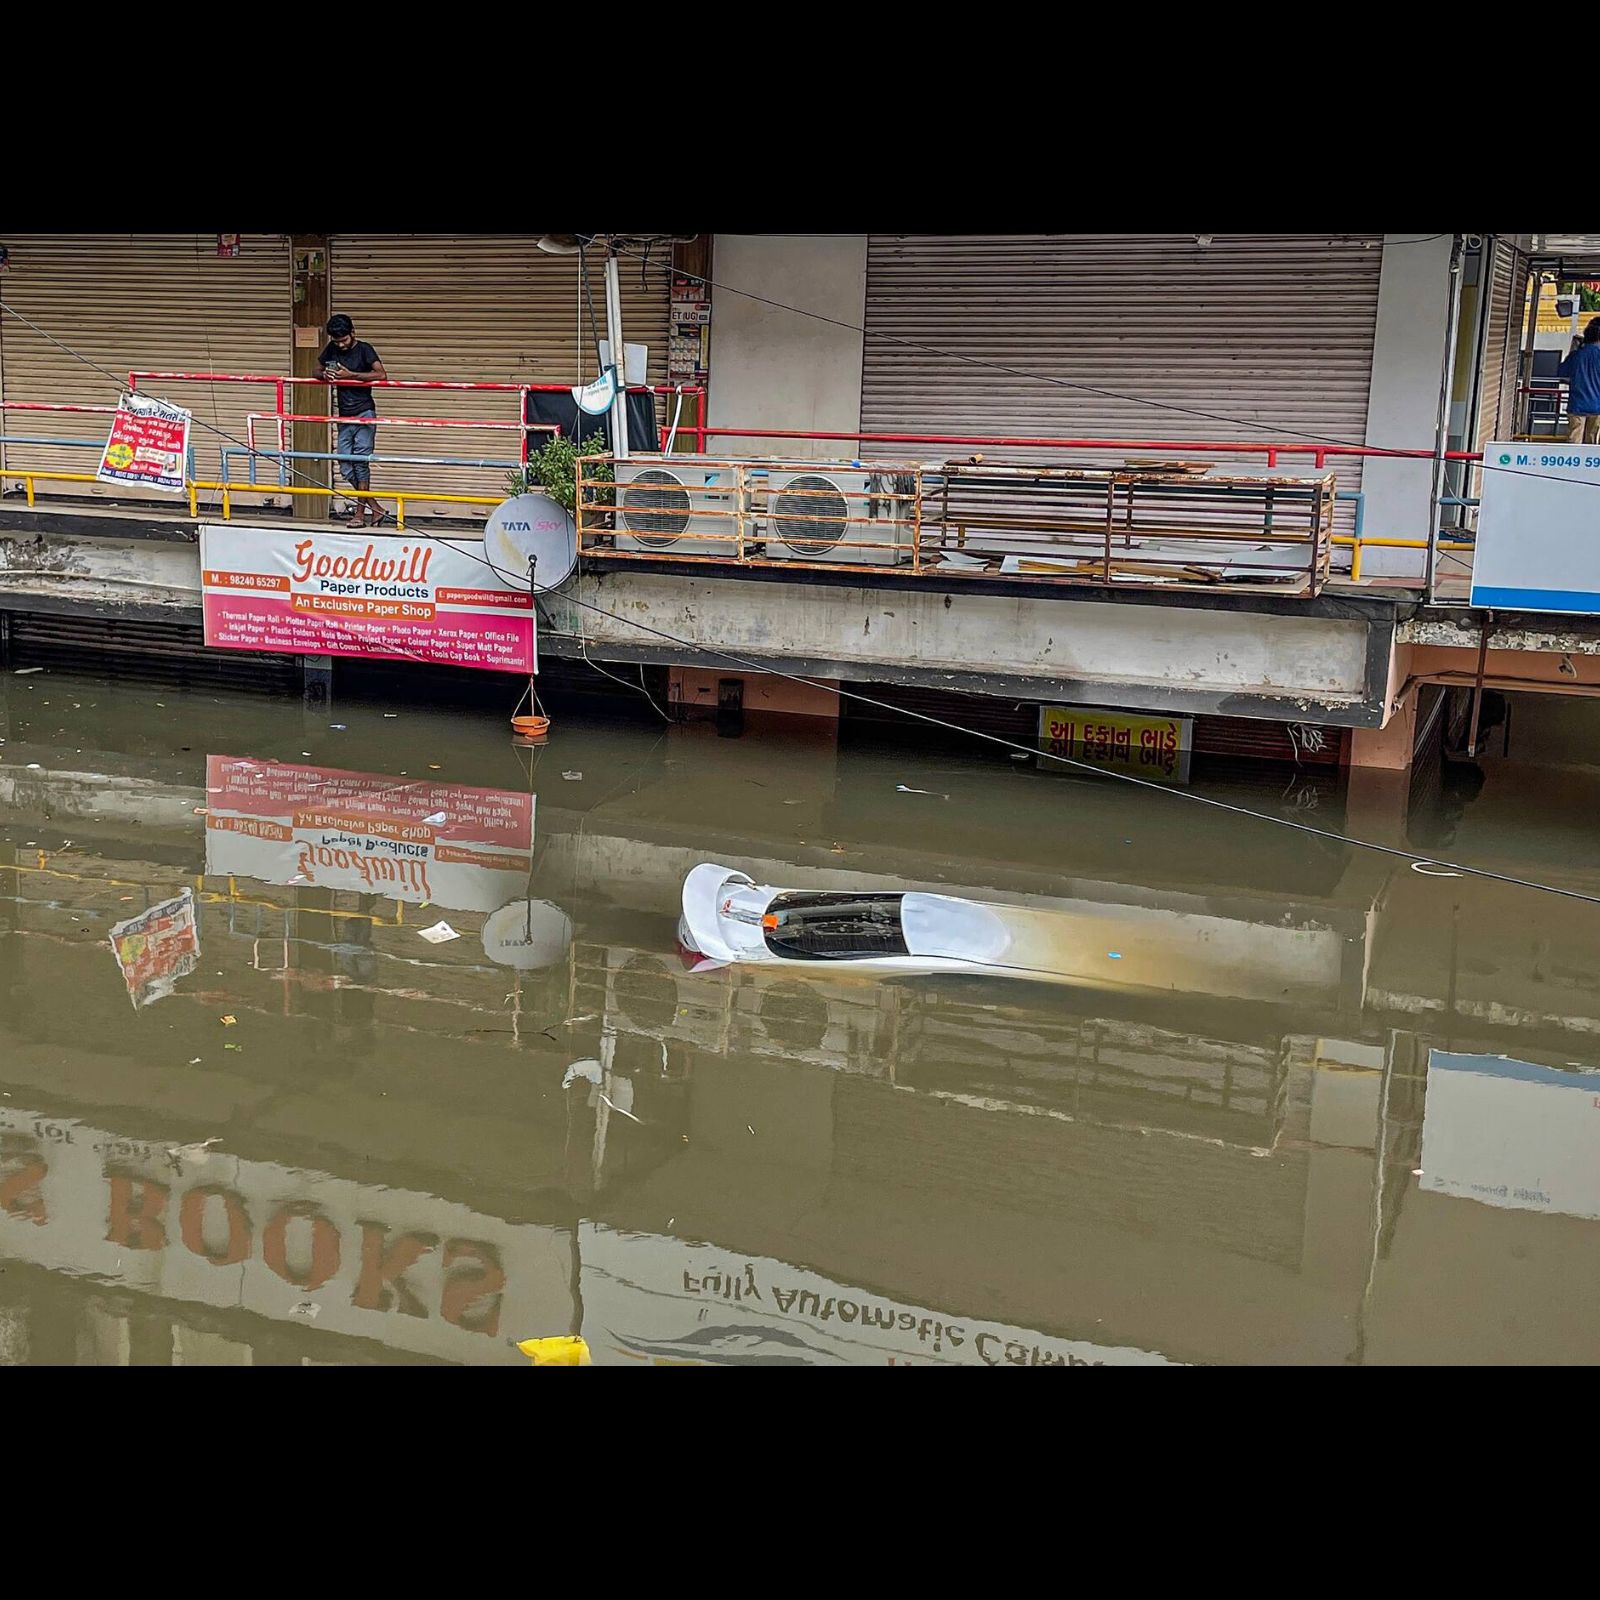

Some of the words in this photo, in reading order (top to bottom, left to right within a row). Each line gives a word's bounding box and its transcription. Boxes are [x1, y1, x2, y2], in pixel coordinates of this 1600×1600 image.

[1541, 456, 1581, 467] 99049
[501, 521, 531, 531] TATA
[292, 539, 433, 583] Goodwill
[229, 575, 255, 586] 98240
[256, 577, 281, 588] 65297
[320, 580, 361, 595] Paper
[365, 583, 429, 599] Products
[295, 596, 310, 608] An
[313, 598, 364, 613] Exclusive
[367, 603, 400, 617] Paper
[402, 604, 432, 619] Shop
[222, 611, 248, 621] Thermal
[249, 613, 266, 623] Paper
[267, 614, 280, 624] Roll
[306, 618, 325, 628] Paper
[344, 622, 366, 632] Printer
[367, 623, 386, 634] Paper
[392, 625, 411, 635] Photo
[413, 626, 432, 637] Paper
[459, 629, 479, 640] Paper
[485, 631, 505, 642] Office
[506, 632, 520, 643] File
[228, 622, 247, 632] Inkjet
[247, 624, 265, 634] Paper
[271, 626, 292, 635] Plastic
[292, 627, 316, 637] Folders
[358, 634, 381, 645] Project
[382, 635, 401, 646] Paper
[407, 637, 430, 647] Colour
[430, 638, 450, 649] Paper
[456, 640, 476, 651] Super
[494, 643, 513, 654] Paper
[219, 632, 240, 641] Sticker
[240, 634, 259, 644] Paper
[265, 635, 292, 645] Business
[430, 649, 449, 659] Fools
[449, 651, 463, 661] Cap
[464, 652, 481, 662] Book
